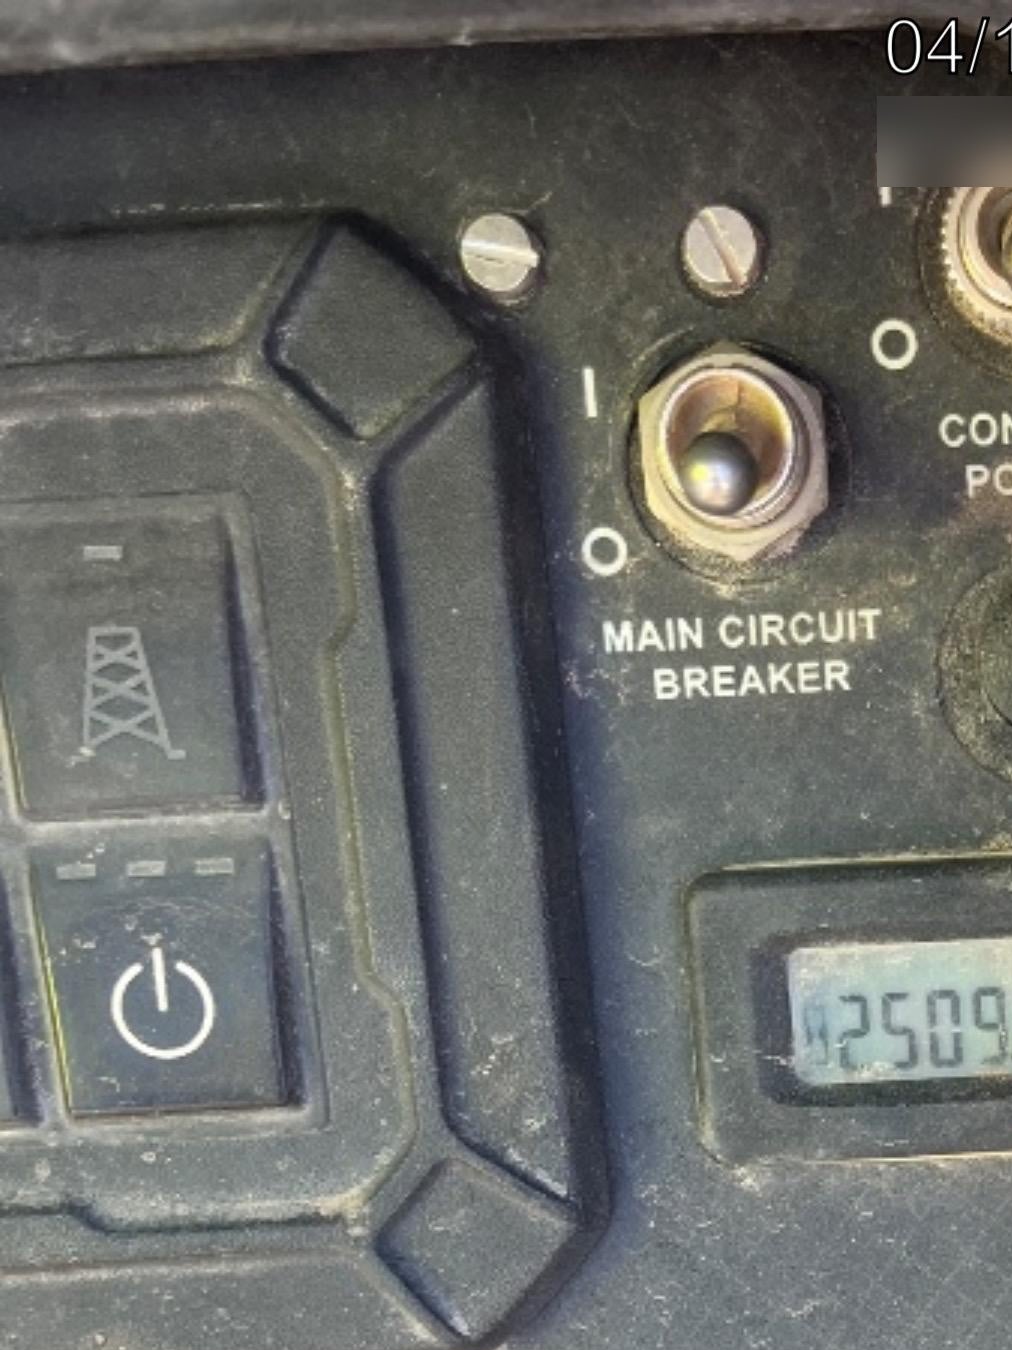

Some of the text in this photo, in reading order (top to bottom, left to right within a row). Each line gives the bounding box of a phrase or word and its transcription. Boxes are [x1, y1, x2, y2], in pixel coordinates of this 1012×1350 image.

[602, 606, 882, 655] MAIN CIRCUIT
[653, 659, 852, 702] BREAKER
